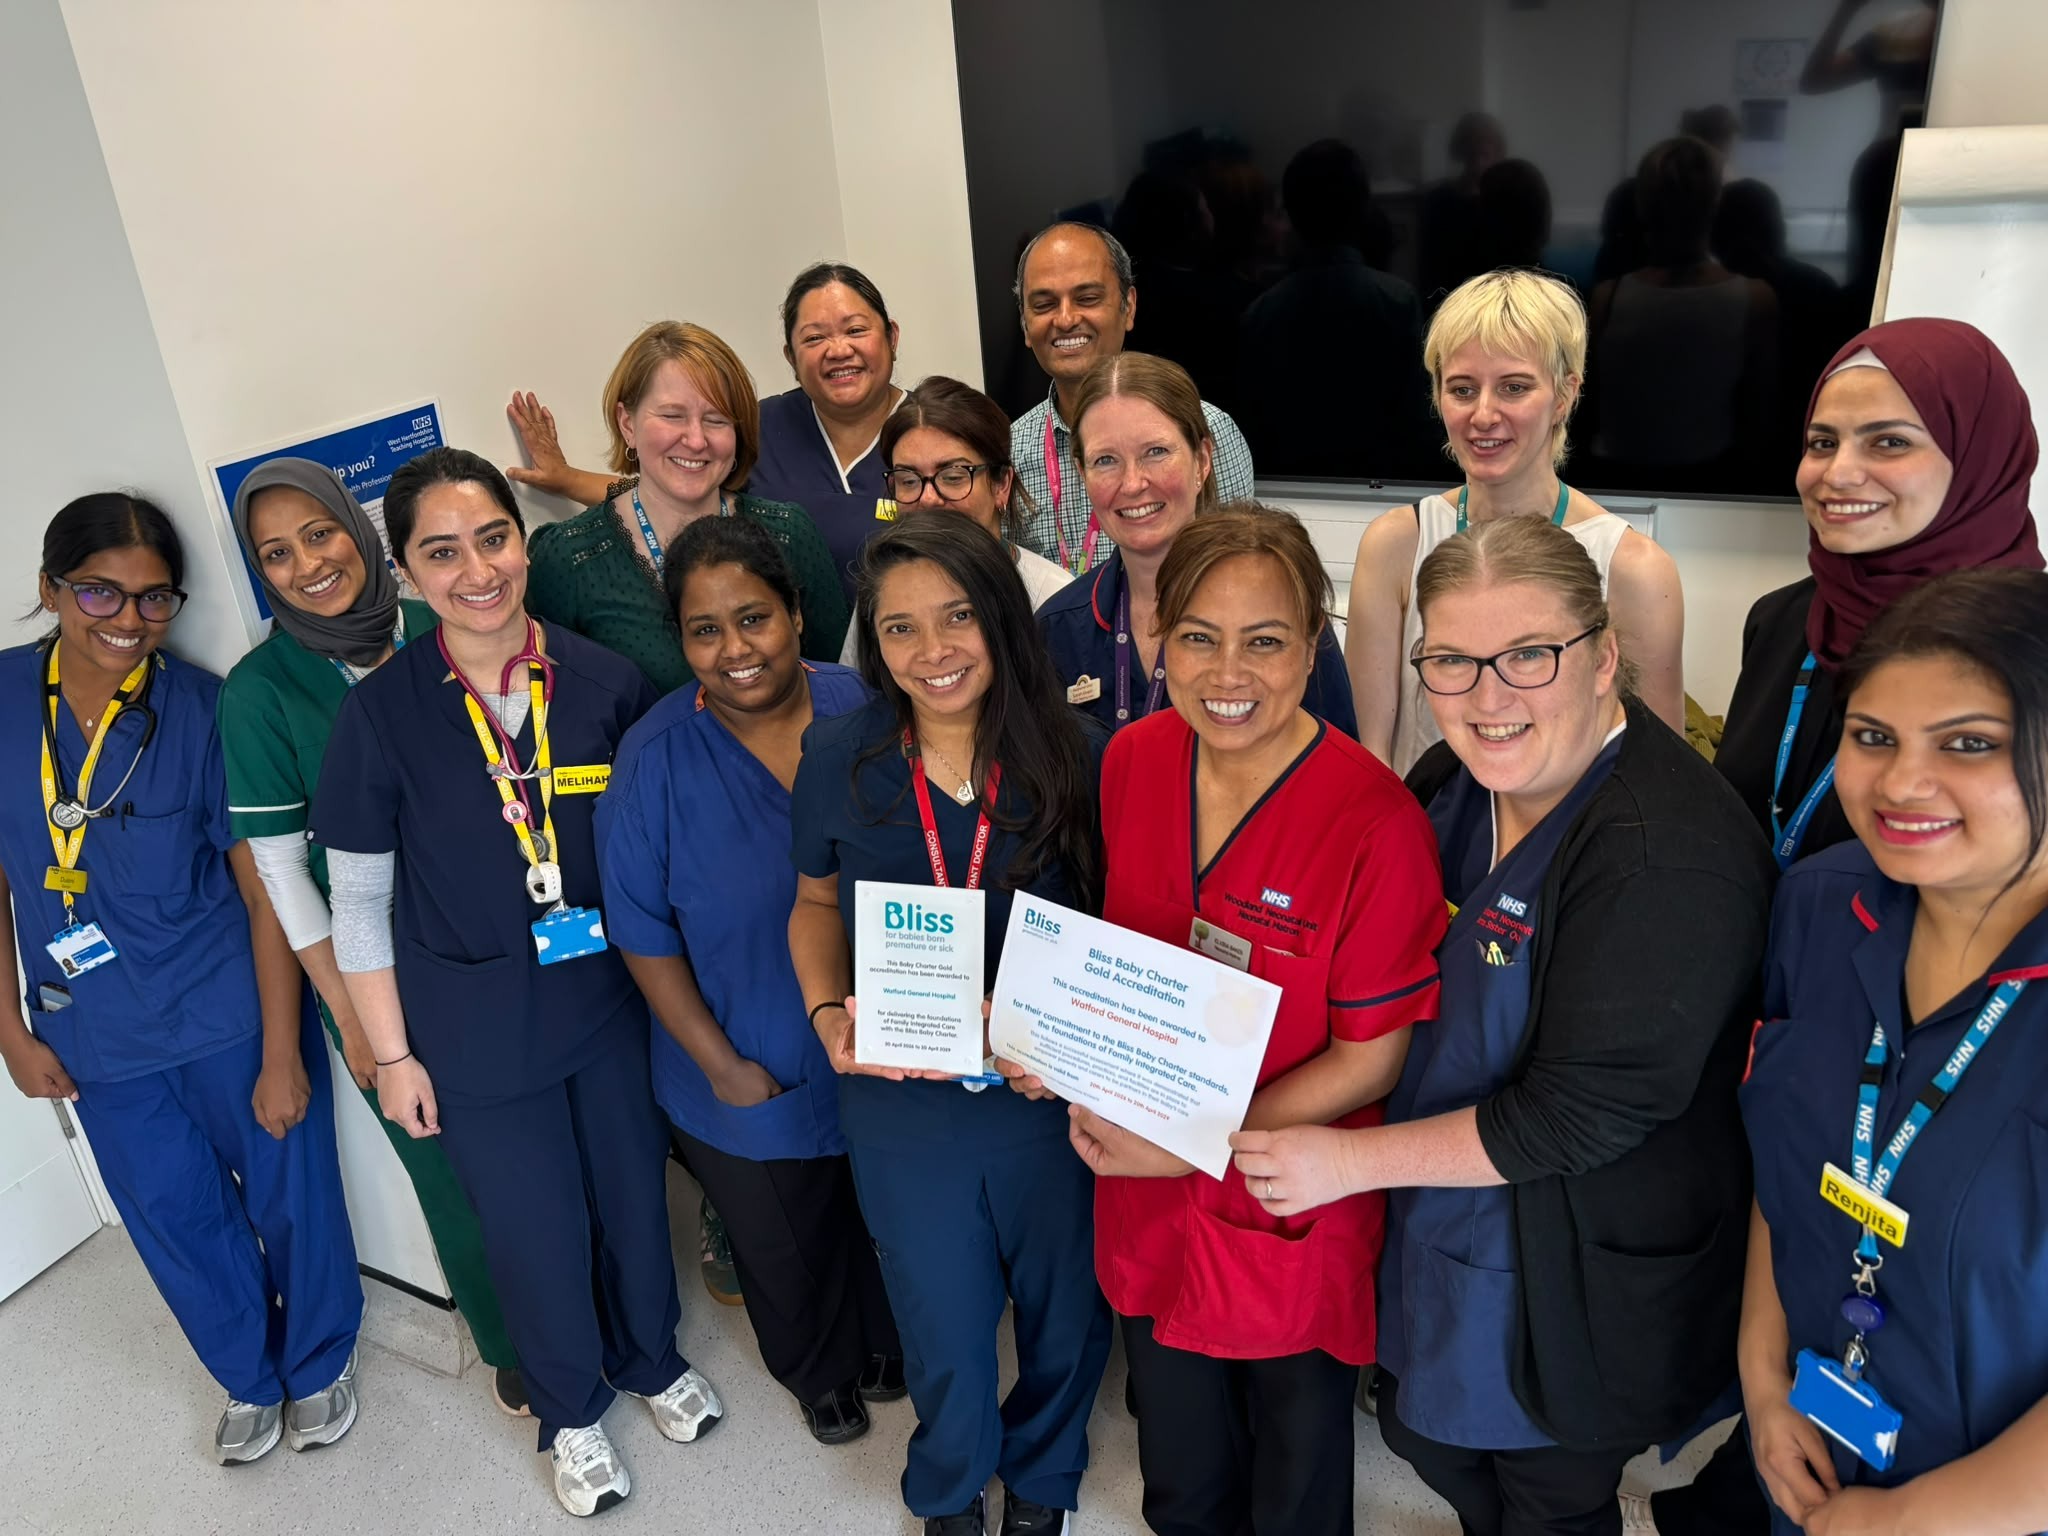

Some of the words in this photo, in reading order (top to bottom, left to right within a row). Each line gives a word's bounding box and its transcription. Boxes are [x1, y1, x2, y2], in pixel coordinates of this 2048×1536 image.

[413, 416, 430, 428] NHS
[387, 438, 400, 446] West
[400, 427, 433, 441] Hertfordshire
[390, 442, 412, 452] Teaching
[412, 434, 435, 445] Hospitals
[332, 465, 346, 480] lp
[347, 455, 377, 477] you?
[348, 482, 360, 493] alth
[361, 473, 392, 488] Profession
[636, 508, 648, 526] NHS
[645, 531, 658, 549] NHS
[477, 721, 495, 754] DOCTOR
[45, 778, 53, 804] OCTOR
[558, 776, 608, 788] MELIHAH
[974, 825, 987, 864] DOCTOR
[1780, 838, 1794, 856] NHS
[1223, 892, 1263, 912] Woodland
[1265, 907, 1303, 925] Neonatal
[1262, 890, 1290, 908] NHS
[1497, 895, 1526, 917] NHS
[884, 901, 954, 933] Bliss
[1023, 908, 1063, 934] Bliss
[1237, 910, 1270, 927] Neonatal
[1272, 922, 1300, 936] Matron
[885, 941, 926, 950] premature
[899, 932, 924, 940] babies
[927, 934, 944, 942] born
[1087, 947, 1113, 964] Bliss
[1114, 957, 1144, 977] Baby
[1145, 968, 1189, 992] Charter
[1083, 961, 1111, 979] Gold
[1112, 972, 1186, 1007] Accreditation
[1051, 977, 1068, 988] This
[1068, 983, 1120, 1008] accreditation
[1121, 1003, 1136, 1014] has
[1137, 1008, 1159, 1022] been
[1159, 1018, 1196, 1038] awarded
[1197, 1033, 1207, 1042] to
[1070, 997, 1105, 1016] Watford
[1105, 1011, 1141, 1030] General
[1141, 1025, 1178, 1045] Hospital
[1976, 996, 2007, 1034] NHS
[1012, 998, 1023, 1008] for
[1024, 1004, 1042, 1015] their
[1042, 1012, 1090, 1035] commitment
[1092, 1031, 1101, 1039] to
[1102, 1035, 1115, 1044] the
[1116, 1040, 1134, 1052] Bliss
[1135, 1048, 1156, 1062] Baby
[1157, 1056, 1188, 1074] Charter
[1187, 1071, 1231, 1095] standards,
[1037, 1020, 1050, 1029] the
[1051, 1026, 1097, 1048] foundations
[1098, 1044, 1106, 1052] of
[1107, 1048, 1133, 1064] Family
[1134, 1059, 1176, 1081] Integrated
[1176, 1077, 1199, 1091] Care.
[1946, 1040, 1975, 1077] NHS
[1856, 1104, 1873, 1142] NHS
[1889, 1121, 1916, 1158] NHS
[1854, 1155, 1868, 1186] NH
[1826, 1180, 1897, 1238] Renjita
